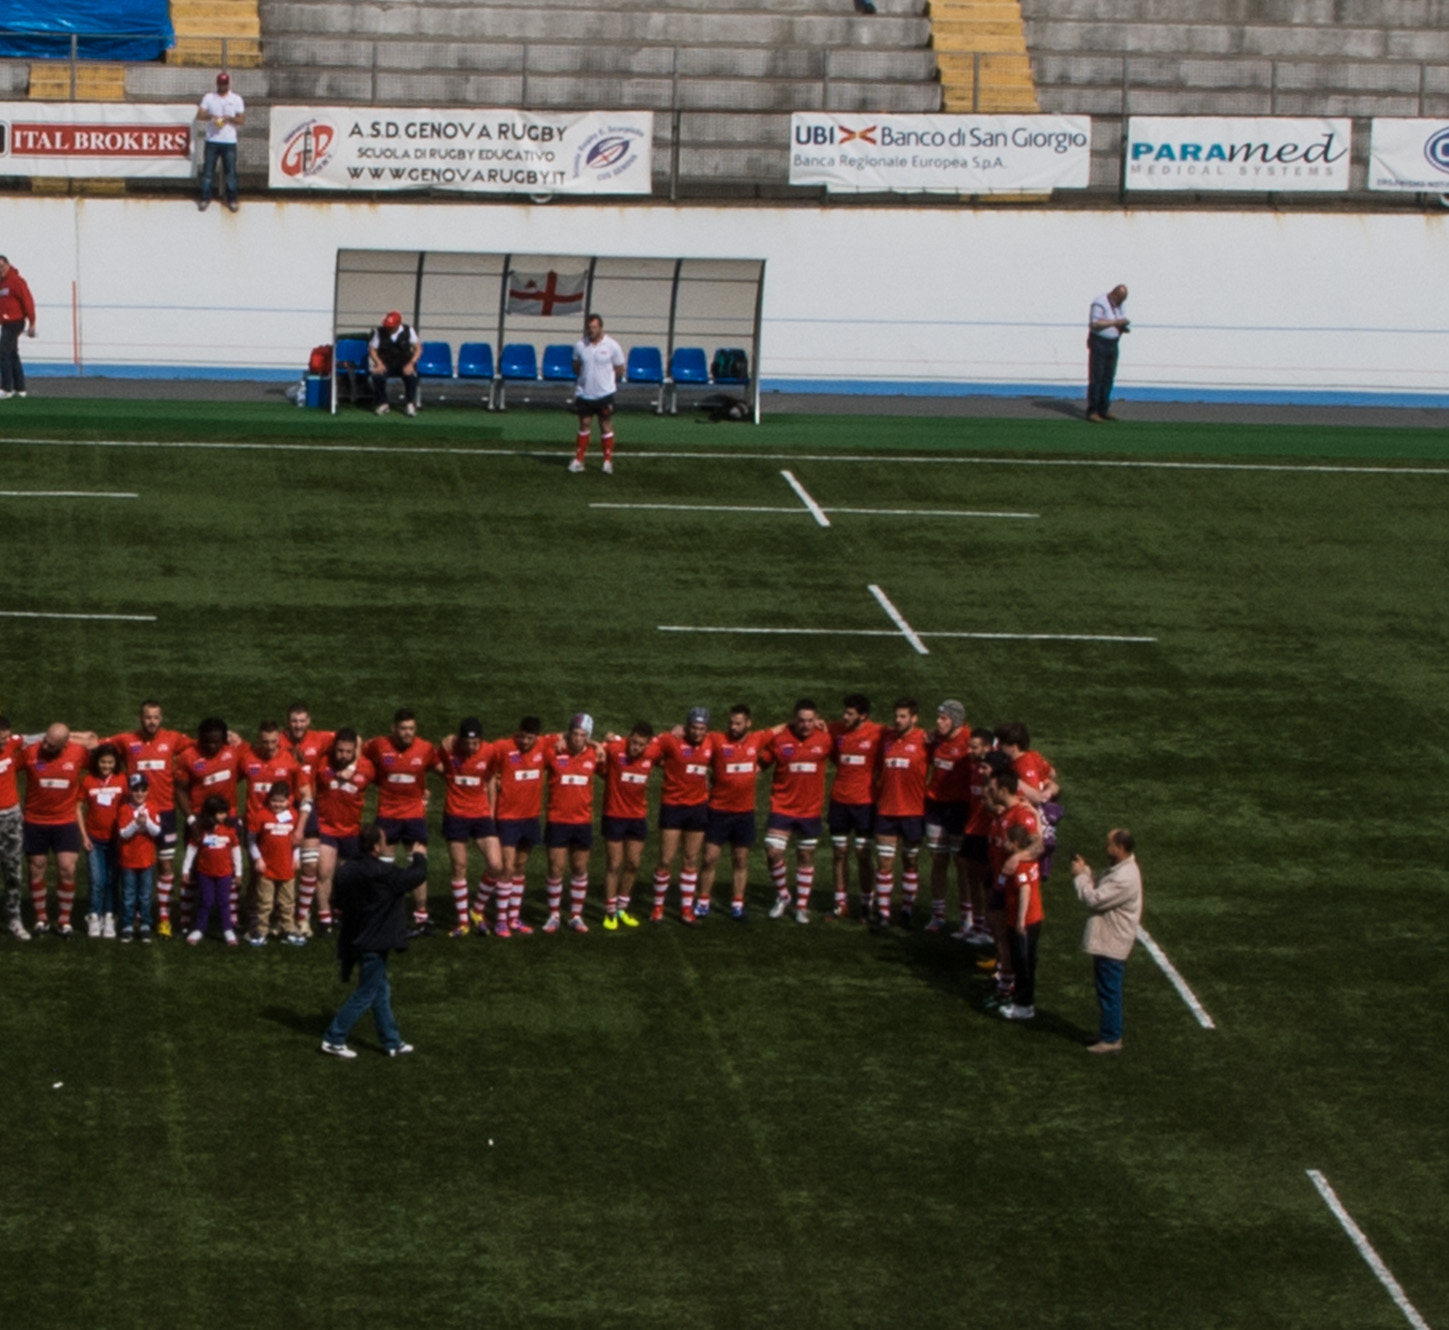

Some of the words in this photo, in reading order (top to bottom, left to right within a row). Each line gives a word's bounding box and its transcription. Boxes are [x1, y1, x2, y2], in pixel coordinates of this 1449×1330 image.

[14, 131, 69, 150] ITAL
[74, 131, 188, 151] BROKERS
[405, 122, 492, 140] GENOVA
[498, 123, 567, 142] RUGBY
[795, 125, 834, 145] UBI
[881, 127, 946, 147] Banco
[948, 128, 966, 147] di
[969, 127, 1008, 147] San
[1012, 128, 1088, 154] Giorgio
[357, 147, 411, 160] SCUOLA
[414, 148, 427, 160] DI
[428, 149, 475, 161] RUGBY
[478, 150, 556, 163] EDUCATIVO
[793, 154, 836, 168] Banca
[839, 155, 908, 171] Regionale
[911, 156, 968, 171] Europea
[1130, 164, 1225, 177] MEDICAL
[1239, 165, 1335, 178] SYSTEMS
